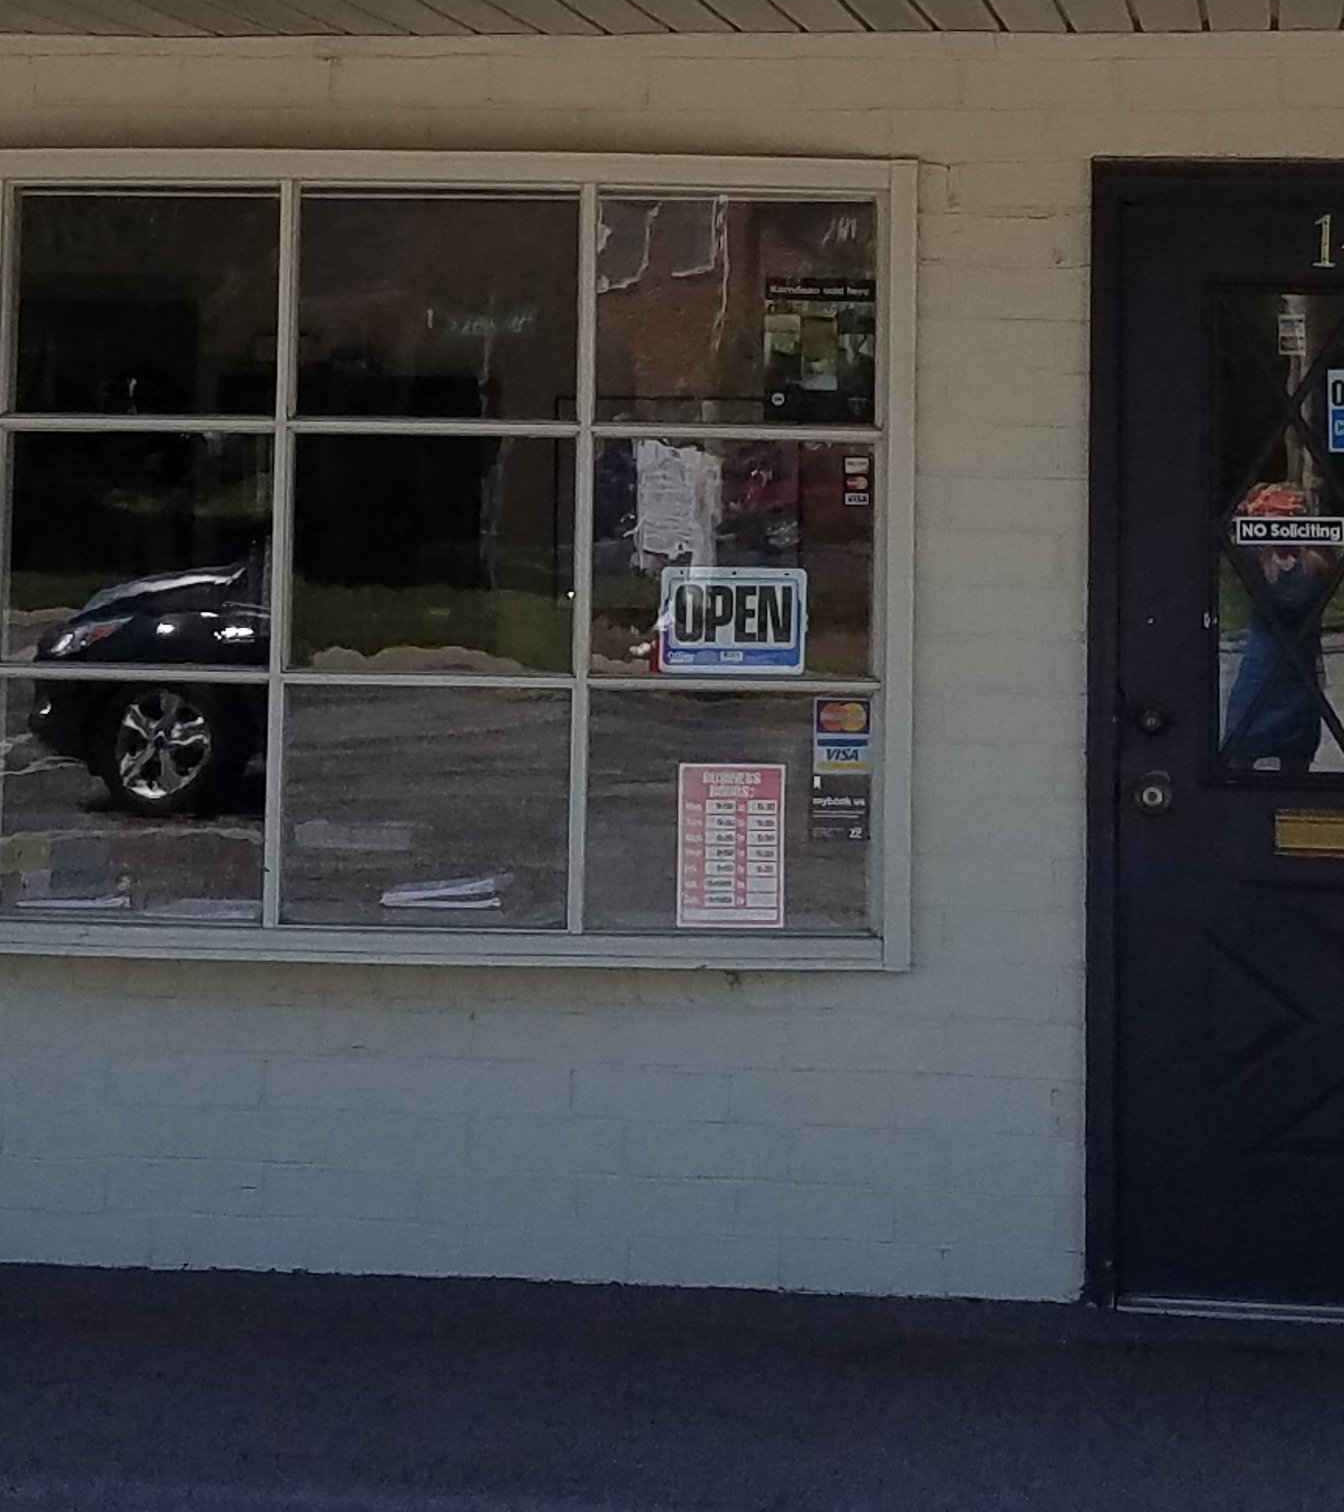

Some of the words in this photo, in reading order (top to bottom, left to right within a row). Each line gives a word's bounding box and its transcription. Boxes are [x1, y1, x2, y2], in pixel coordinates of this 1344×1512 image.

[1241, 522, 1267, 538] NO
[1270, 522, 1341, 542] Soliciting
[675, 584, 793, 643] OPEN
[826, 748, 859, 761] VISA
